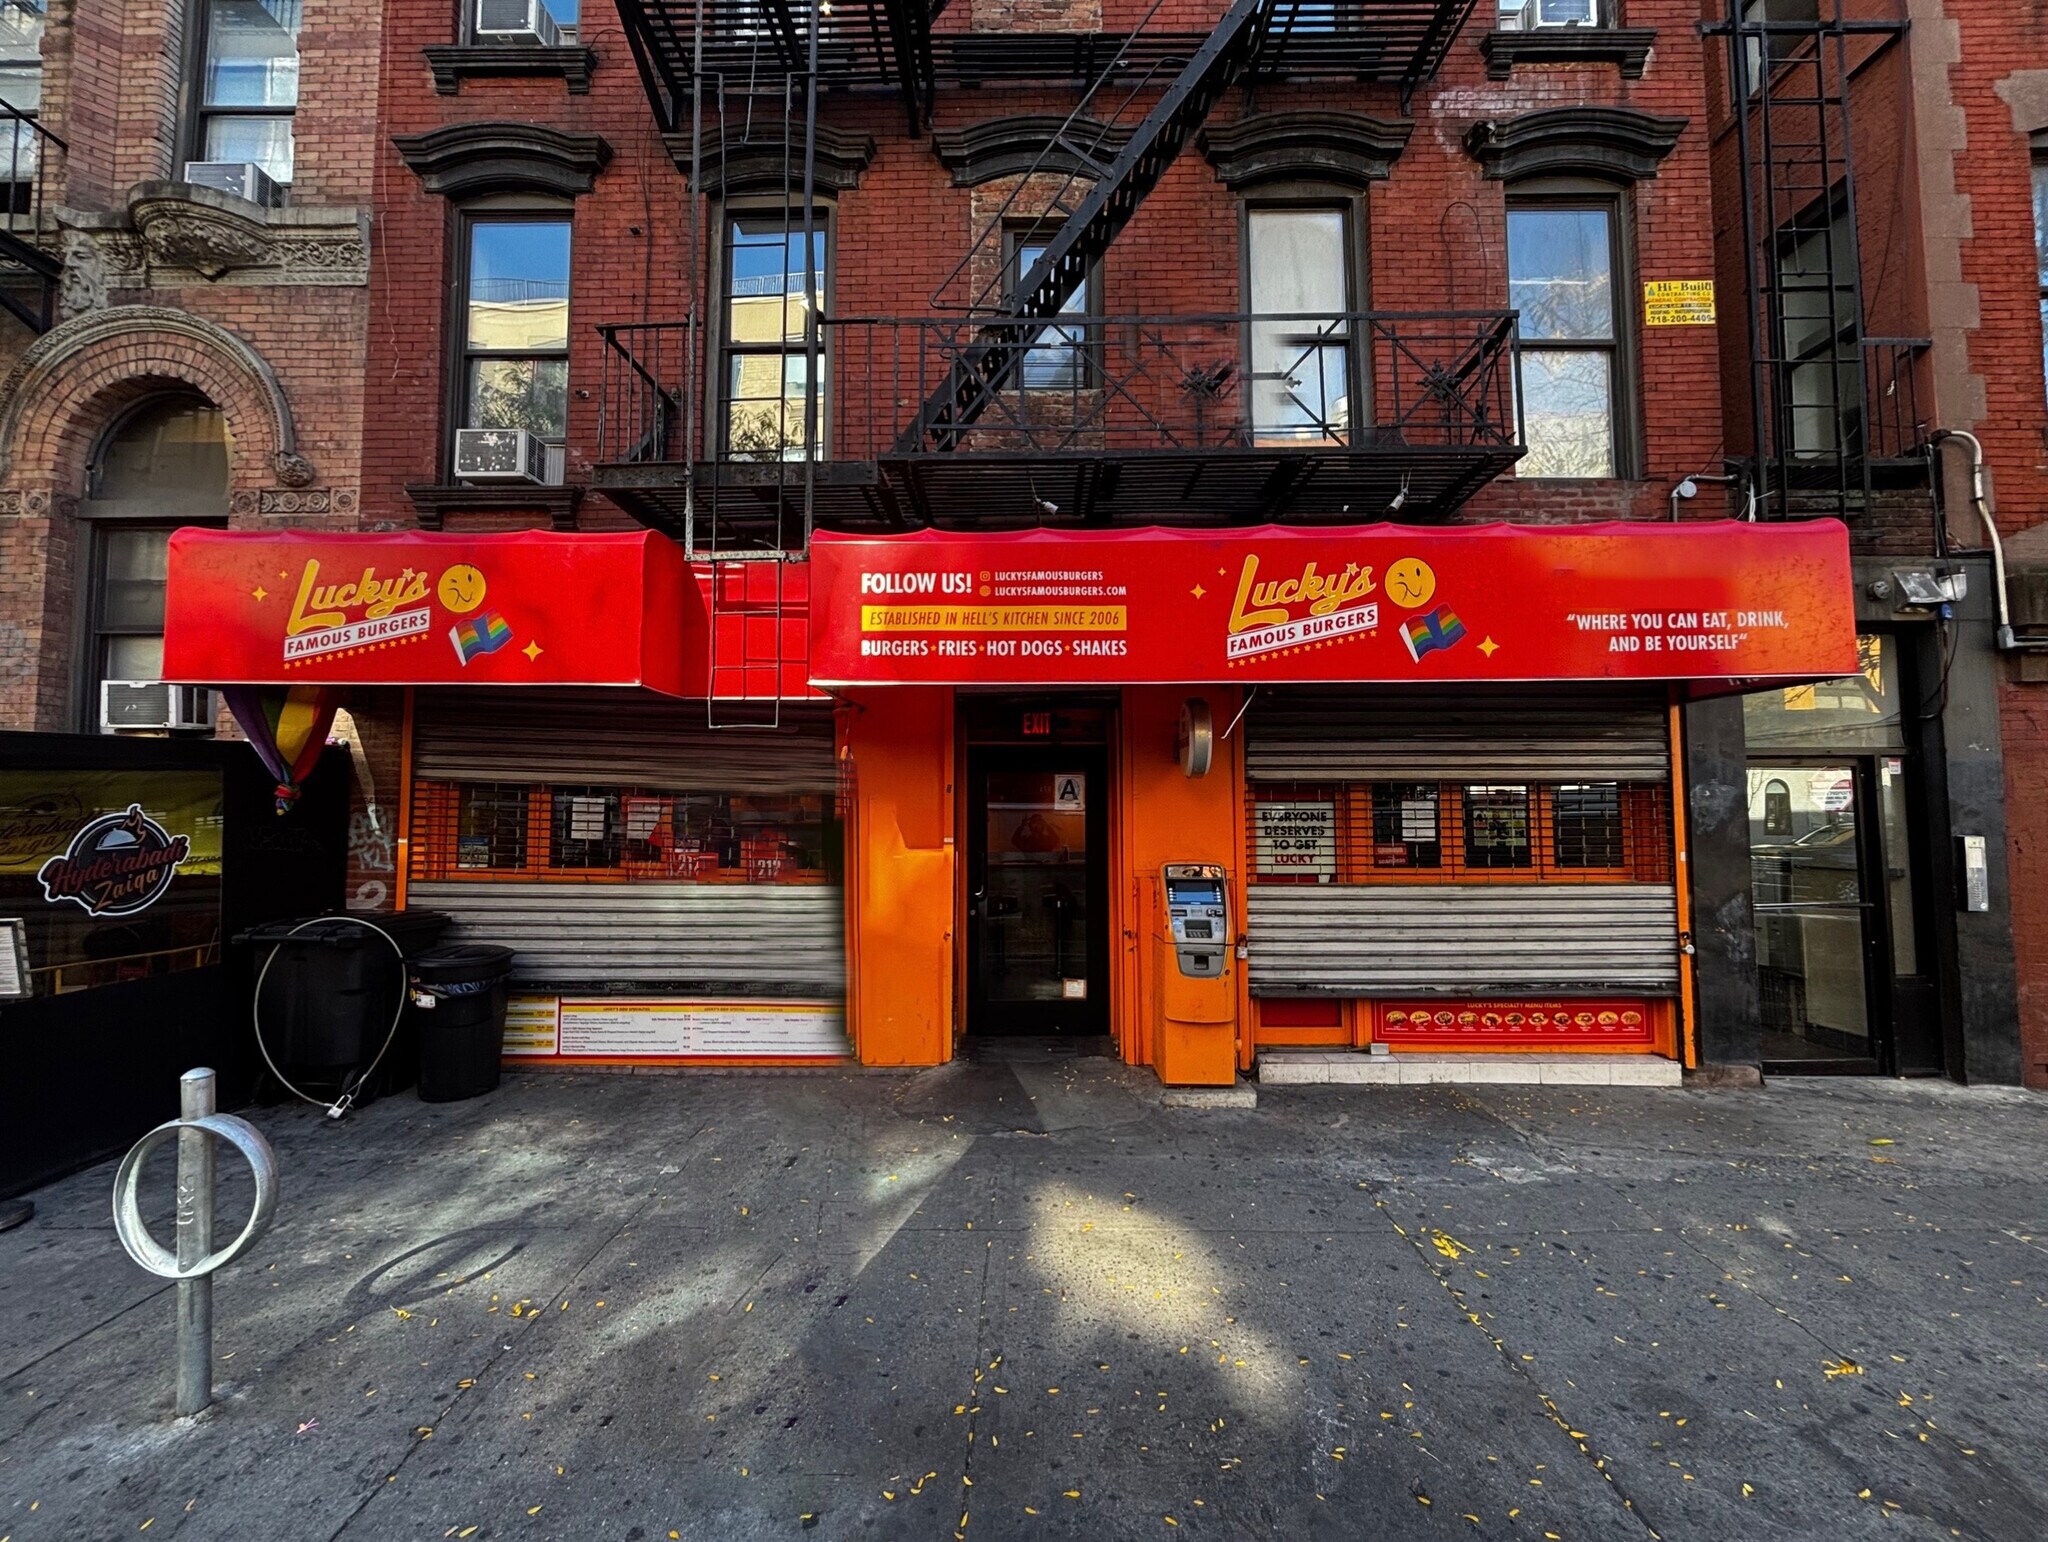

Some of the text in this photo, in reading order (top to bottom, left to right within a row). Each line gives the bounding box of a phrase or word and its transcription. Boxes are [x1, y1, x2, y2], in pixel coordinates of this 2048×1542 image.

[861, 572, 973, 594] FOLLOW US!
[995, 571, 1104, 581] LUCKYSFAMOUSBURGERS
[995, 585, 1127, 597] LUCKYSFAMOUSBURGERS.COM
[870, 611, 1120, 626] ESTABLISHED IN HELL’S KITCHEN SINCE 2006
[1631, 613, 1662, 629] YOU
[1668, 613, 1698, 629] CAN
[1703, 612, 1732, 630] EAT,
[1737, 611, 1789, 630] DRINK,
[287, 613, 428, 654] FAMOUS BURGERS
[1230, 609, 1376, 653] FAMOUS BURGERS
[861, 640, 1127, 656] BURGERS FRIES HOT DOGS SHAKES
[1609, 636, 1640, 652] AND
[1645, 635, 1662, 651] BE
[1023, 713, 1051, 734] EXIT
[1059, 779, 1078, 800] A
[1262, 811, 1327, 821] EVERYONE
[1264, 826, 1325, 835] DESERVES
[1273, 839, 1317, 850] TO GET
[46, 836, 188, 896] Hyderabadi
[1275, 853, 1315, 864] LUCKY
[93, 868, 159, 911] Zaiqa
